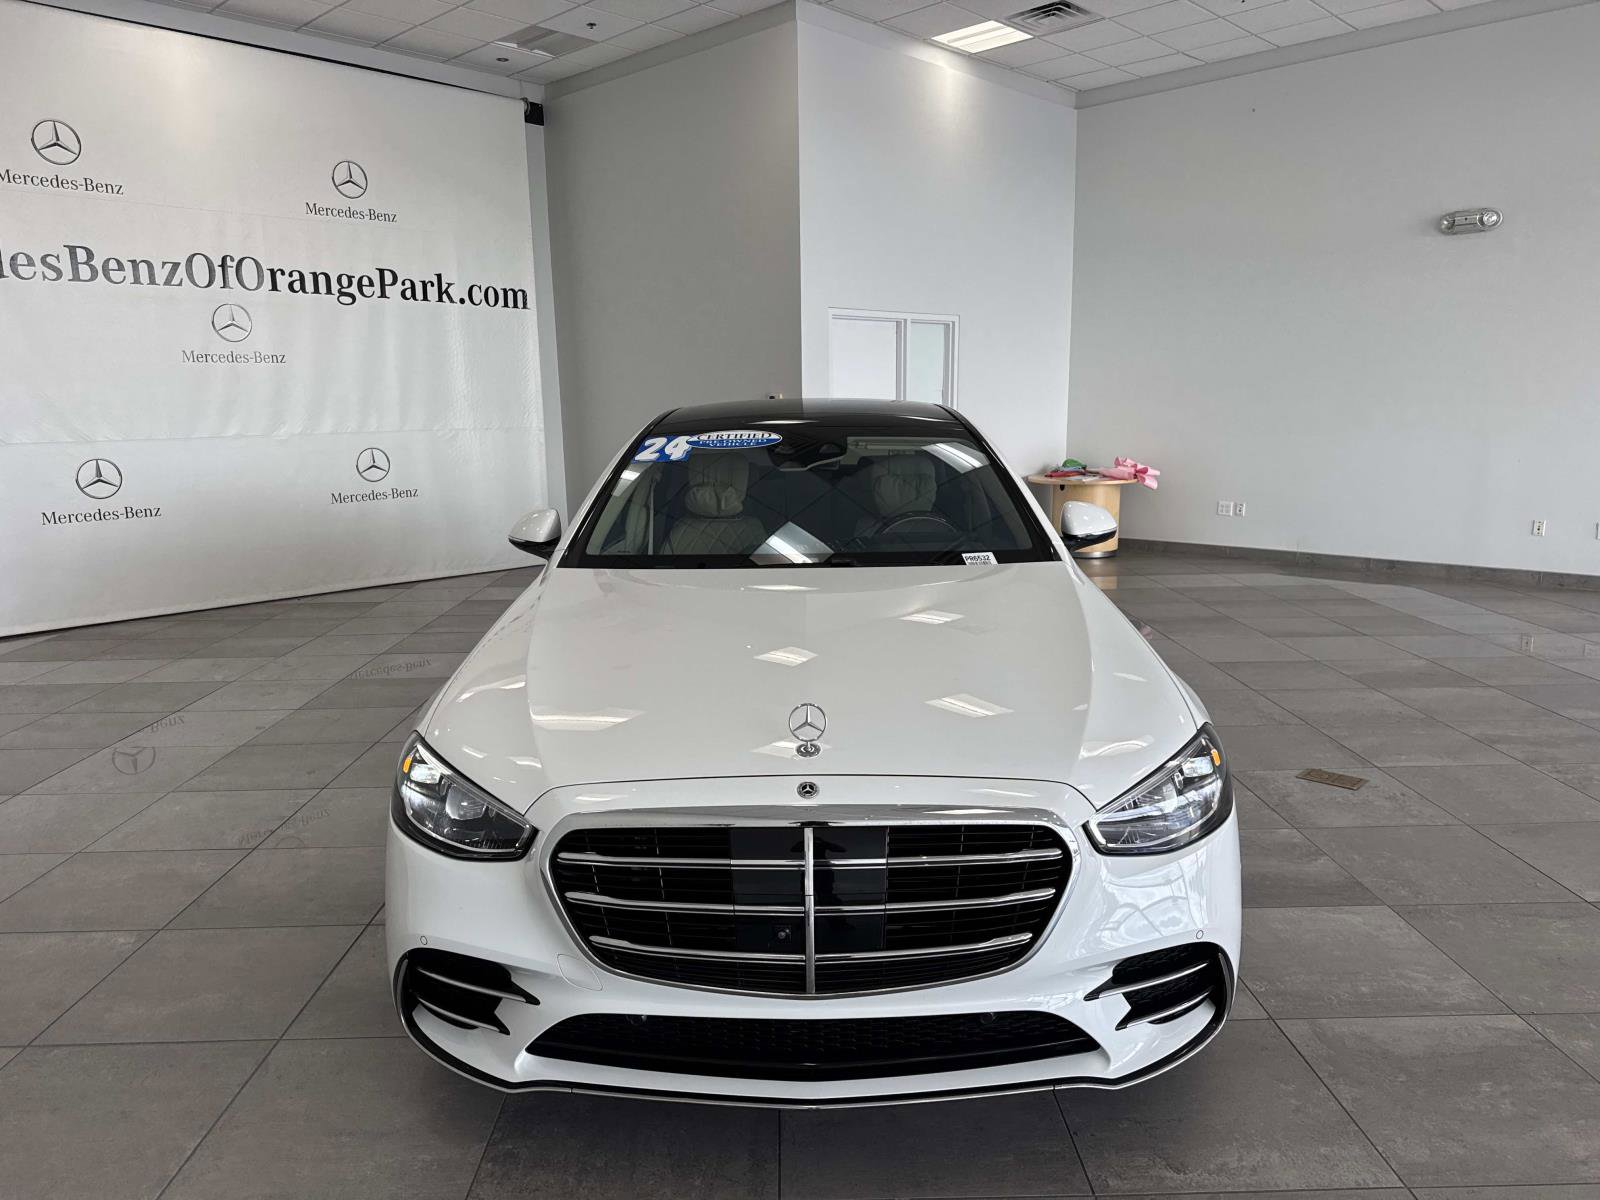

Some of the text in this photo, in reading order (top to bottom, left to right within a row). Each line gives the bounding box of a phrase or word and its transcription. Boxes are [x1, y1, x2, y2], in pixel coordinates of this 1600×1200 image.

[0, 169, 124, 195] Mercedes-Benz
[305, 203, 398, 223] Mercedes-Benz
[182, 350, 286, 365] Mercedes-Benz
[697, 431, 773, 440] CERTIFIED
[634, 435, 692, 462] 24
[330, 486, 419, 504] Mercedes-Benz
[41, 505, 162, 526] Mercedes-Benz
